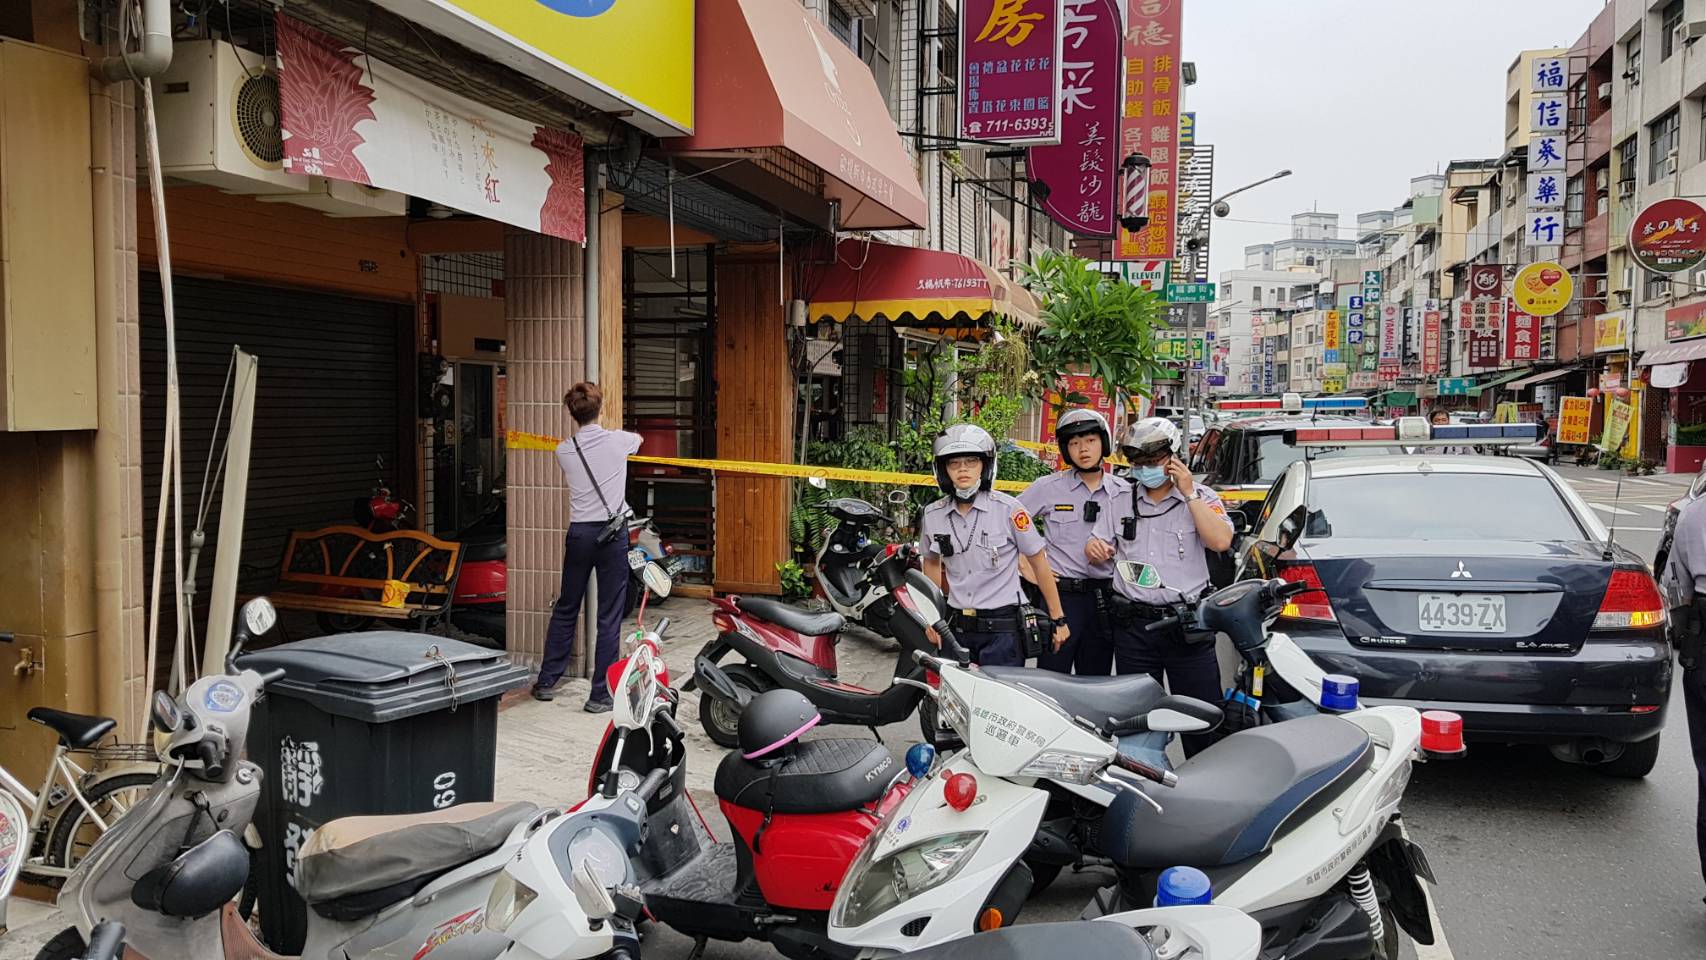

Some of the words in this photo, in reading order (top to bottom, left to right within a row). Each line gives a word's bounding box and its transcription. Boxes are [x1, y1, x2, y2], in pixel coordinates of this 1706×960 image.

[1125, 57, 1144, 118] 自助餐
[1151, 54, 1172, 117] 排骨飯
[986, 117, 1048, 133] 711-6393
[1150, 125, 1170, 185] 雞腿飯
[1532, 60, 1564, 242] 福信蔘藥行
[1385, 319, 1395, 351] YAMAHA
[973, 706, 1047, 748] 高雄市政府警察局
[433, 771, 456, 809] 60
[864, 757, 893, 782] KYMCO
